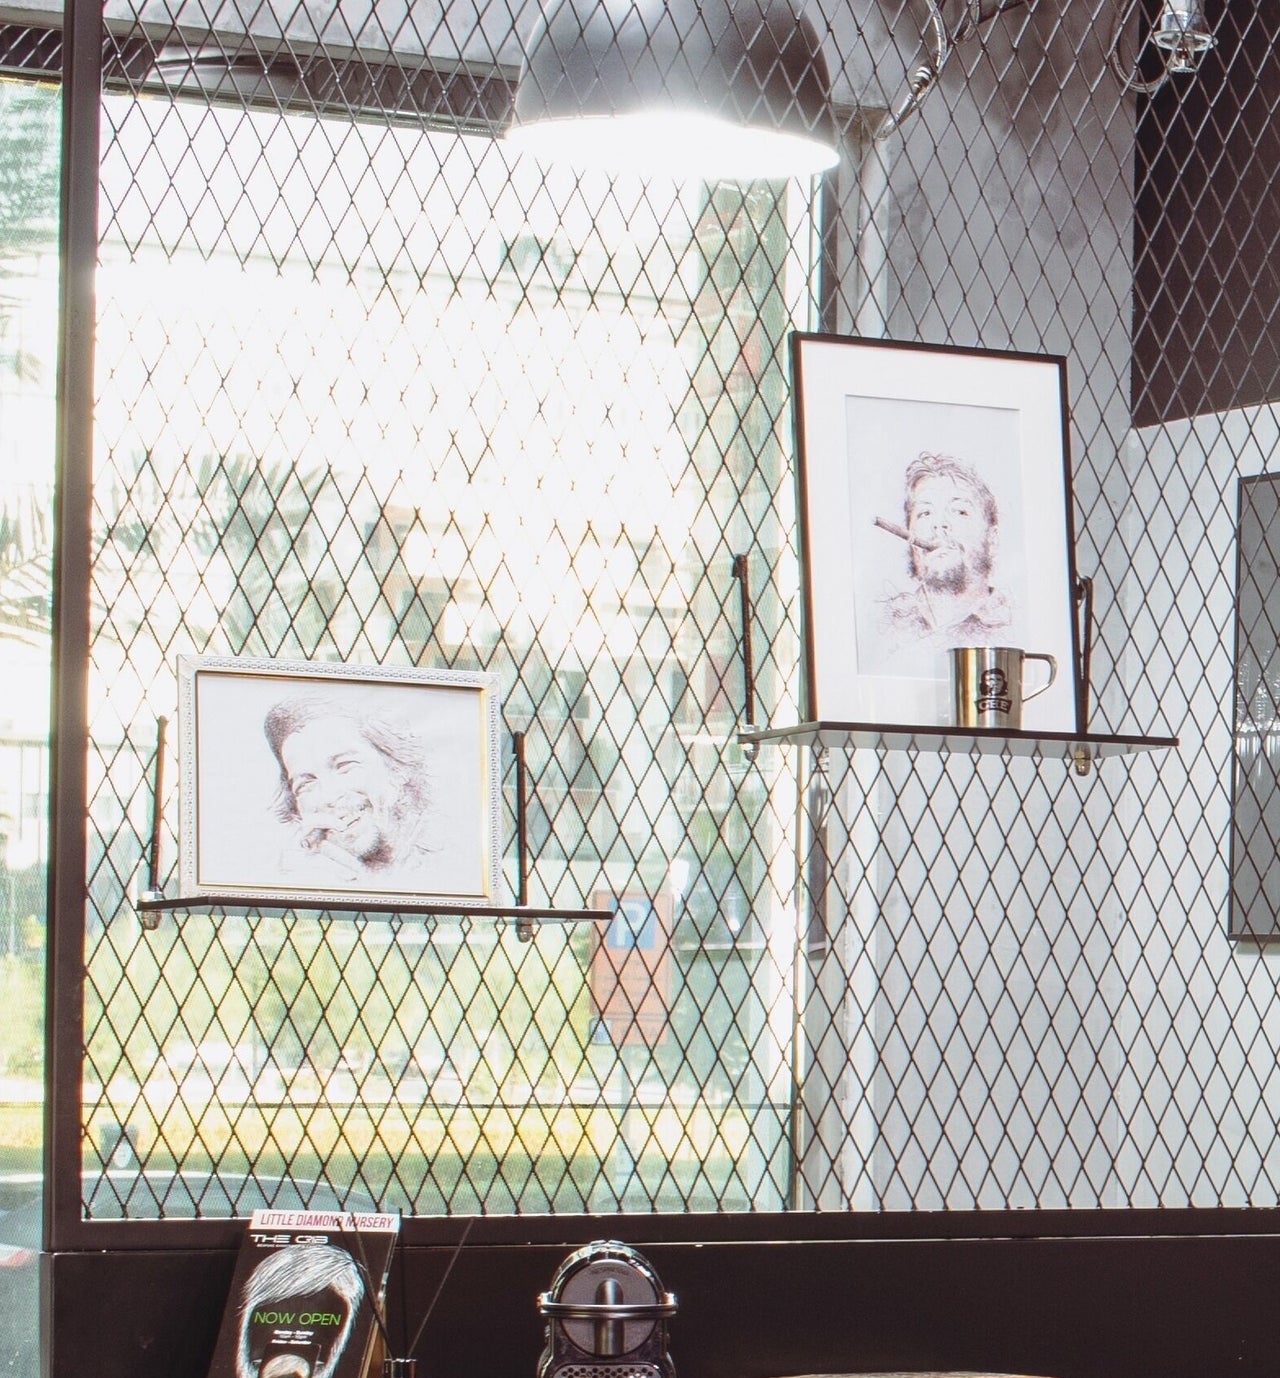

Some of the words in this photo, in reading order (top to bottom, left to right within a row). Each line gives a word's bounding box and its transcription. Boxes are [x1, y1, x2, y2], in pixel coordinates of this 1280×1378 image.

[616, 901, 647, 946] P
[260, 1213, 293, 1226] LITTLE
[296, 1214, 344, 1227] DIAMOND
[345, 1216, 395, 1229] NURSERY
[250, 1234, 291, 1244] THE
[254, 1311, 296, 1324] NOW
[299, 1312, 341, 1326] OPEN
